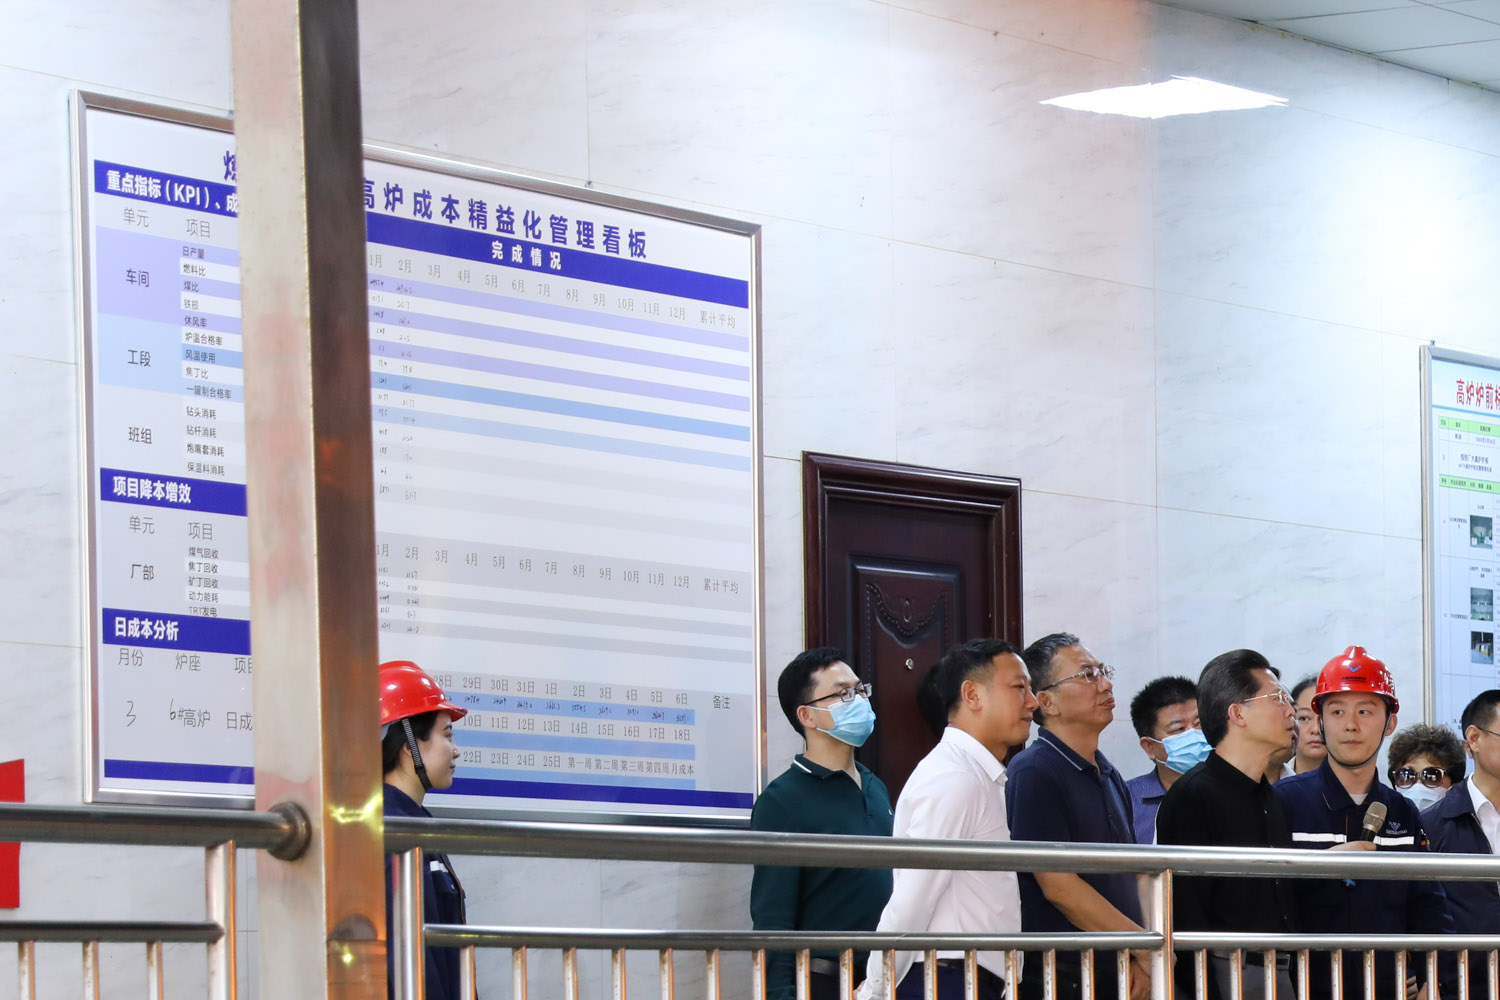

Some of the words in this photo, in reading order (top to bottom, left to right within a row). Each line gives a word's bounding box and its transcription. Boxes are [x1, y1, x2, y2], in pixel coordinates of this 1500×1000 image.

[123, 208, 149, 228] 单元
[186, 218, 211, 239] 项目
[182, 246, 205, 259] 日产量
[491, 240, 562, 270] 完成情况
[126, 268, 150, 287] 车间
[370, 254, 382, 268] 1月
[398, 260, 412, 274] 2月
[428, 264, 441, 278] 3月
[458, 269, 470, 284] 4月
[485, 274, 498, 288] 5月
[512, 279, 524, 293] 6月
[538, 284, 550, 298] 7月
[566, 288, 579, 302] 8月
[594, 293, 606, 308] 9月
[618, 298, 634, 312] 10月
[644, 302, 660, 316] 11月
[669, 306, 686, 320] 12月
[700, 310, 736, 329] 累计平均
[184, 315, 207, 327] 休风率
[185, 332, 223, 346] 炉温合格率
[127, 349, 151, 367] 工段
[185, 349, 216, 363] 风温使用
[185, 366, 209, 379] 焦丁比
[186, 406, 216, 420] 钻头消耗
[128, 426, 152, 444] 班组
[186, 425, 217, 438] 钻杆消耗
[187, 462, 225, 476] 保温料消耗
[113, 476, 192, 504] 项目降本增效
[129, 515, 155, 534] 单元
[188, 522, 213, 541] 项目
[188, 547, 219, 560] 煤气回收
[131, 563, 155, 581] 厂部
[188, 561, 218, 574] 焦丁回收
[376, 544, 389, 558] 1月
[406, 546, 418, 560] 2月
[436, 550, 448, 564] 3月
[465, 552, 478, 566] 4月
[492, 556, 505, 570] 5月
[520, 558, 532, 572] 6月
[546, 562, 557, 575] 7月
[573, 564, 585, 578] 8月
[600, 567, 612, 581] 9月
[623, 570, 640, 584] 10月
[648, 573, 664, 586] 11月
[674, 576, 690, 589] 12月
[703, 577, 739, 594] 累计平均
[188, 576, 218, 589] 矿丁回收
[188, 591, 219, 603] 动力能耗
[189, 606, 217, 618] TRT发电
[115, 616, 179, 642] 日成本分析
[118, 648, 144, 667] 月份
[175, 653, 201, 672] 炉座
[463, 676, 482, 690] 29日
[491, 679, 509, 692] 30日
[517, 681, 535, 694] 31日
[546, 683, 557, 695] 1日
[573, 685, 585, 697] 2日
[600, 687, 612, 700] 3日
[626, 689, 638, 702] 4日
[650, 691, 663, 704] 5日
[676, 693, 688, 706] 6日
[713, 695, 730, 710] 备注
[463, 715, 482, 728] 10日
[491, 716, 509, 729] 11日
[517, 718, 535, 732] 12日
[543, 720, 560, 733] 13日
[571, 722, 588, 735] 14日
[598, 724, 614, 737] 15日
[624, 726, 640, 738] 16日
[649, 727, 665, 740] 17日
[674, 729, 690, 742] 18日
[463, 751, 482, 764] 22日
[491, 752, 509, 765] 23日
[517, 754, 535, 767] 24日
[543, 755, 561, 768] 25日
[568, 756, 592, 771] 第一周
[594, 758, 619, 771] 第二周
[620, 760, 644, 773] 第三周
[646, 761, 670, 775] 第四周
[671, 762, 695, 776] 月成本
